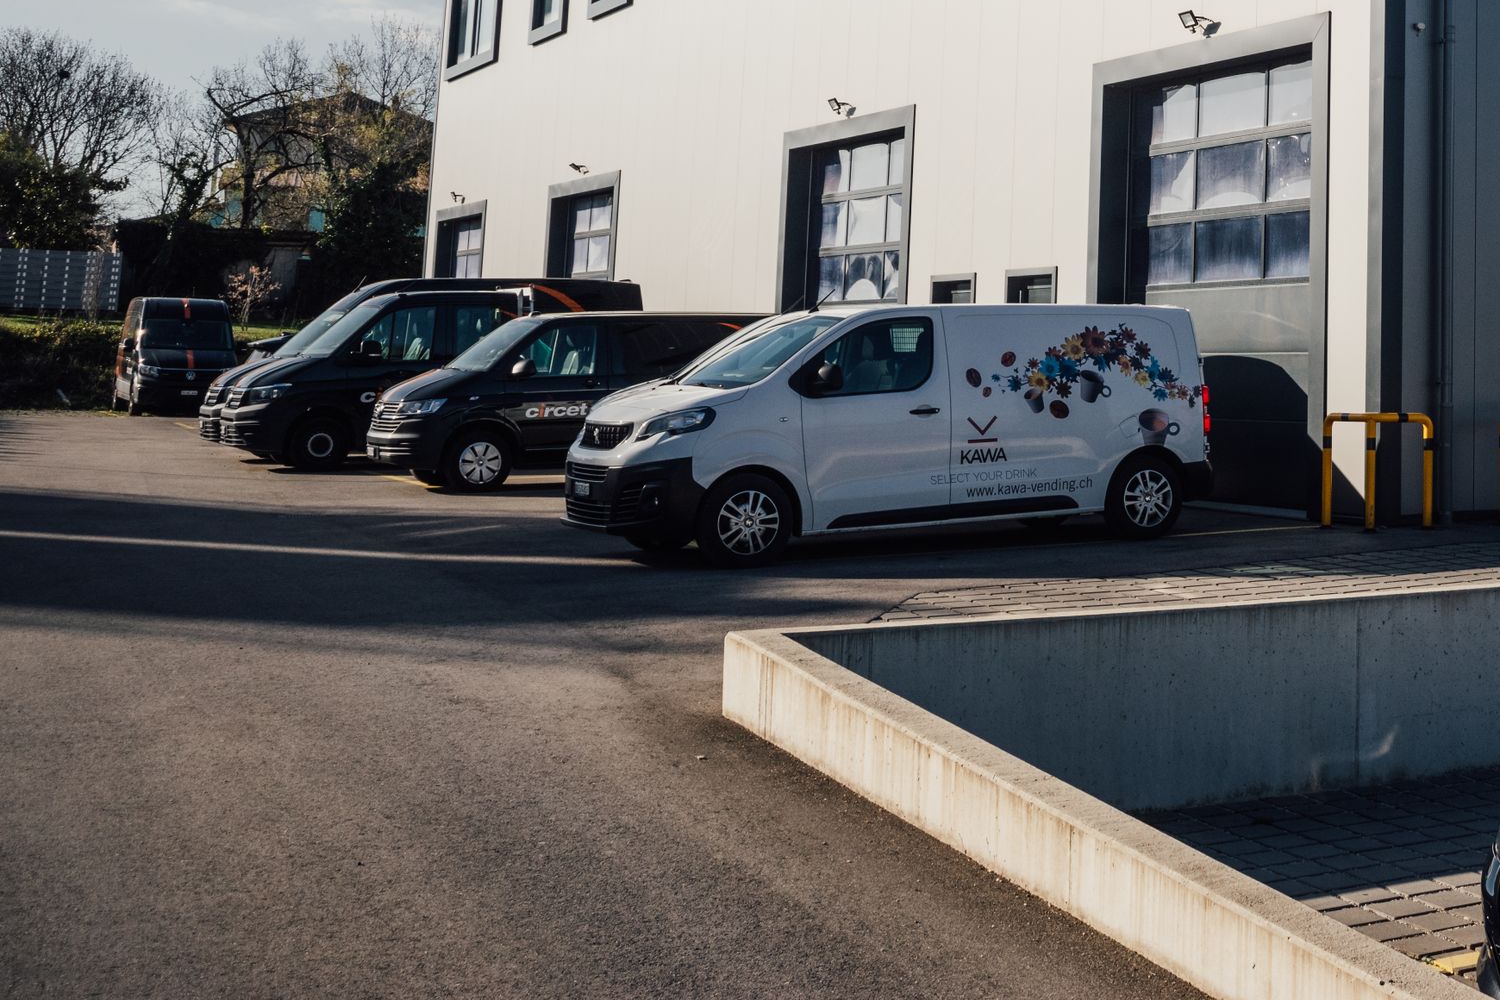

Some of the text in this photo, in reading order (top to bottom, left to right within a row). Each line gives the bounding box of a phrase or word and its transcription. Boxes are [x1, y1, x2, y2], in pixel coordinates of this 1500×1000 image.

[525, 402, 588, 419] circet
[960, 447, 1008, 465] KAWA
[930, 468, 1038, 486] SELECT YOUR DRINK
[966, 476, 1093, 498] www.kawa-vending.ch
